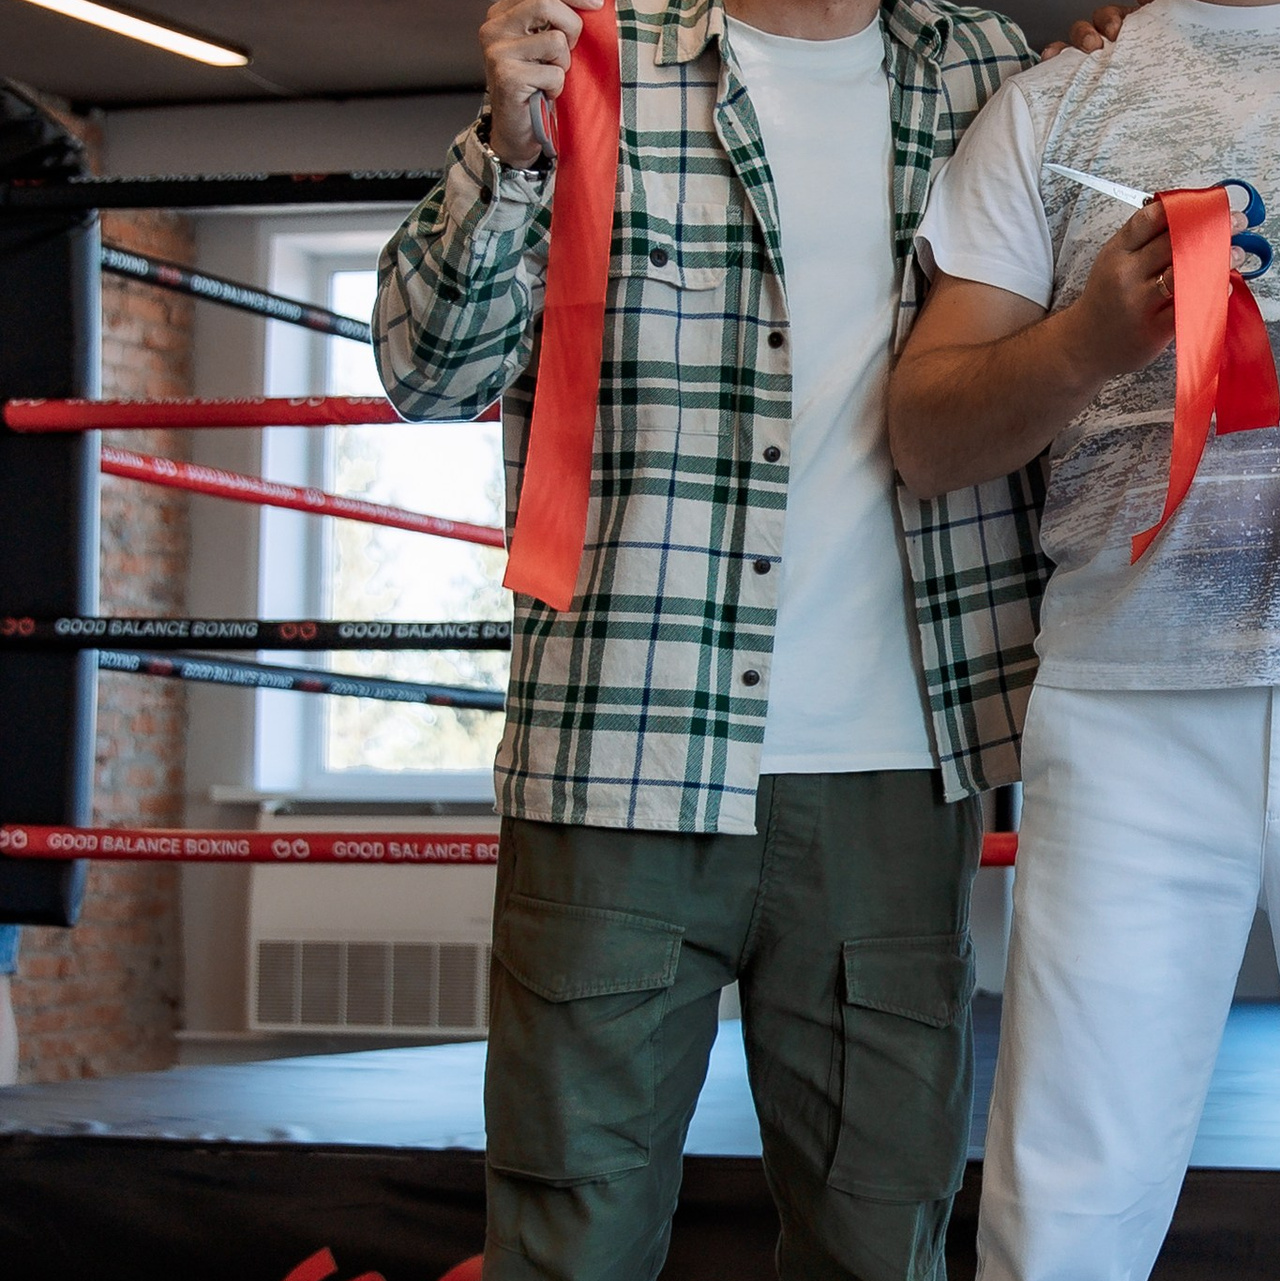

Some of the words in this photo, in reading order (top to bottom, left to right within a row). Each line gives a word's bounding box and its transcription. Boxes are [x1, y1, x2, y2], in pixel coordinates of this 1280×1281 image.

[55, 618, 106, 635] GOOD
[108, 619, 189, 637] BALANCE
[191, 621, 259, 638] BOXING
[338, 622, 392, 638] GOOD
[394, 622, 479, 639] BALANCE
[47, 832, 98, 851] GOOD
[102, 835, 181, 854] BALANCE
[184, 838, 250, 856] BOXING
[332, 840, 385, 858] GOOD
[387, 841, 471, 859] BALANCE
